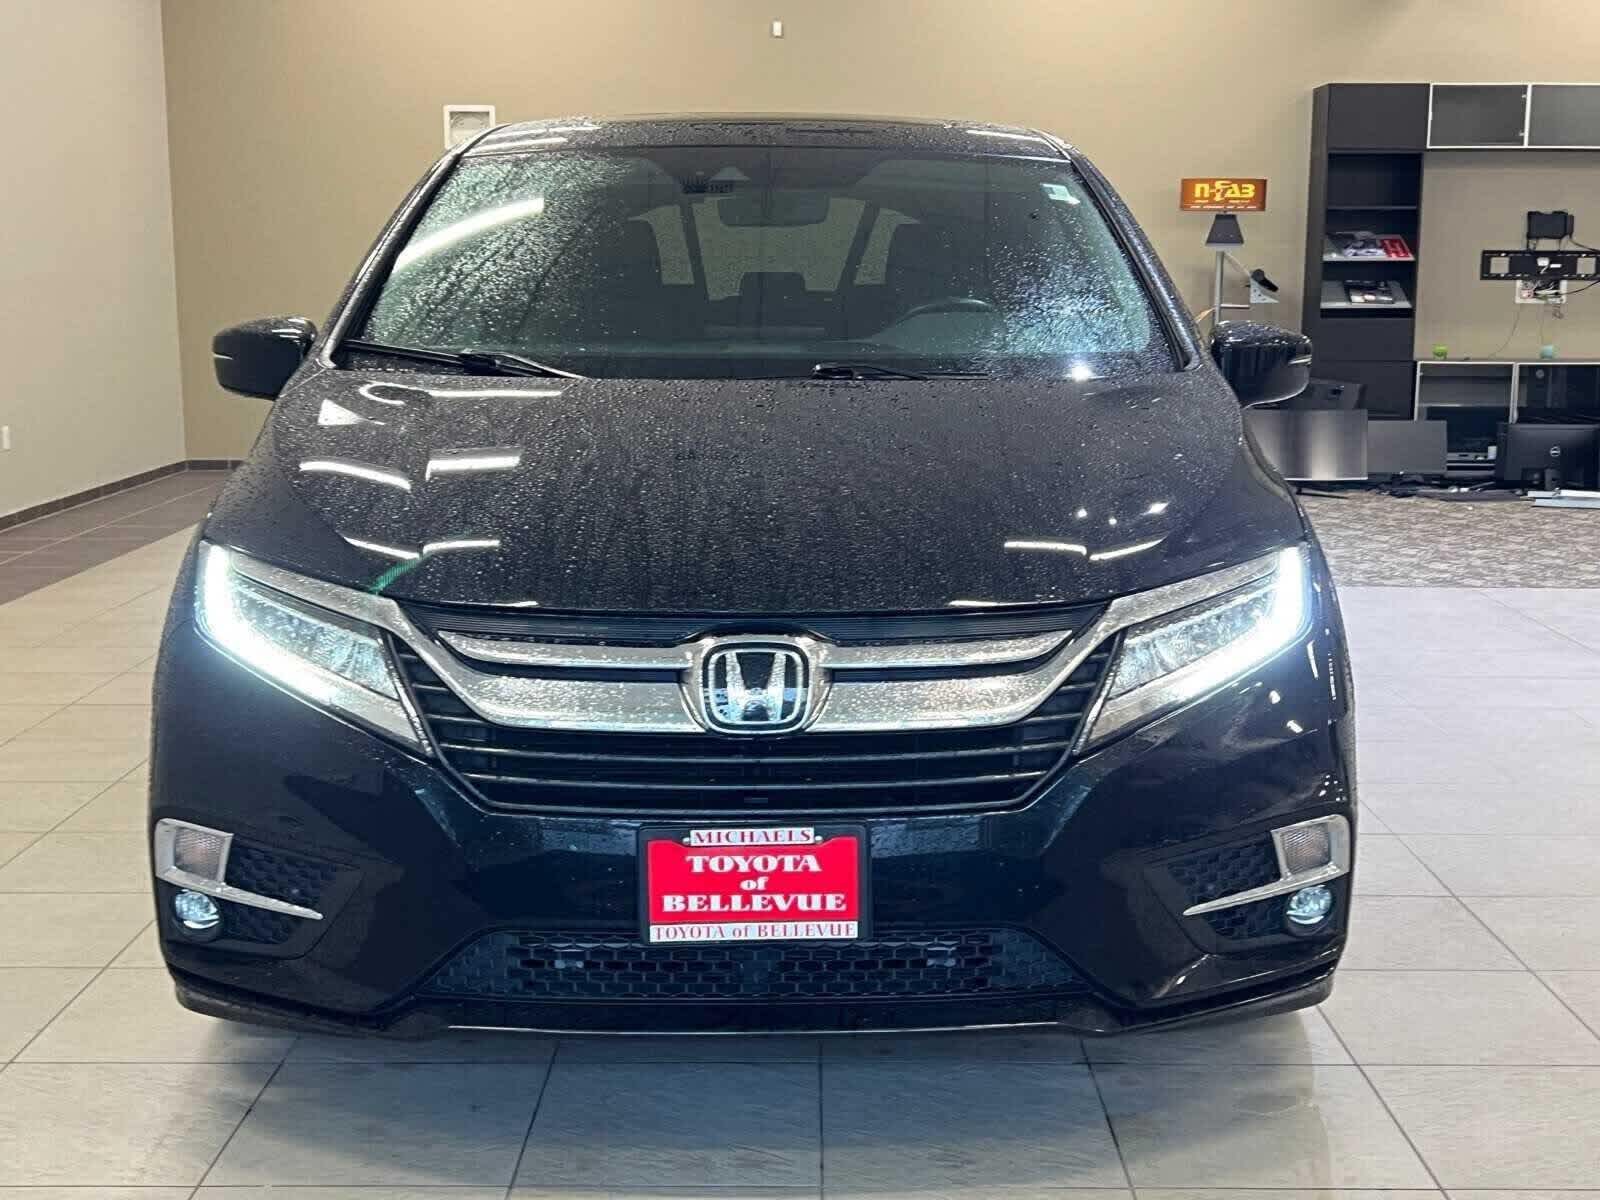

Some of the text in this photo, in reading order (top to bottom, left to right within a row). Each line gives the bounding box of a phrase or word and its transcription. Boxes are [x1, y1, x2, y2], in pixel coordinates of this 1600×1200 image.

[694, 829, 812, 844] MICHAELS
[686, 855, 822, 873] TOYOTA
[740, 877, 769, 891] of
[662, 894, 847, 912] BELLEVUE
[655, 922, 856, 940] TOYOTA of BELLEVUE
